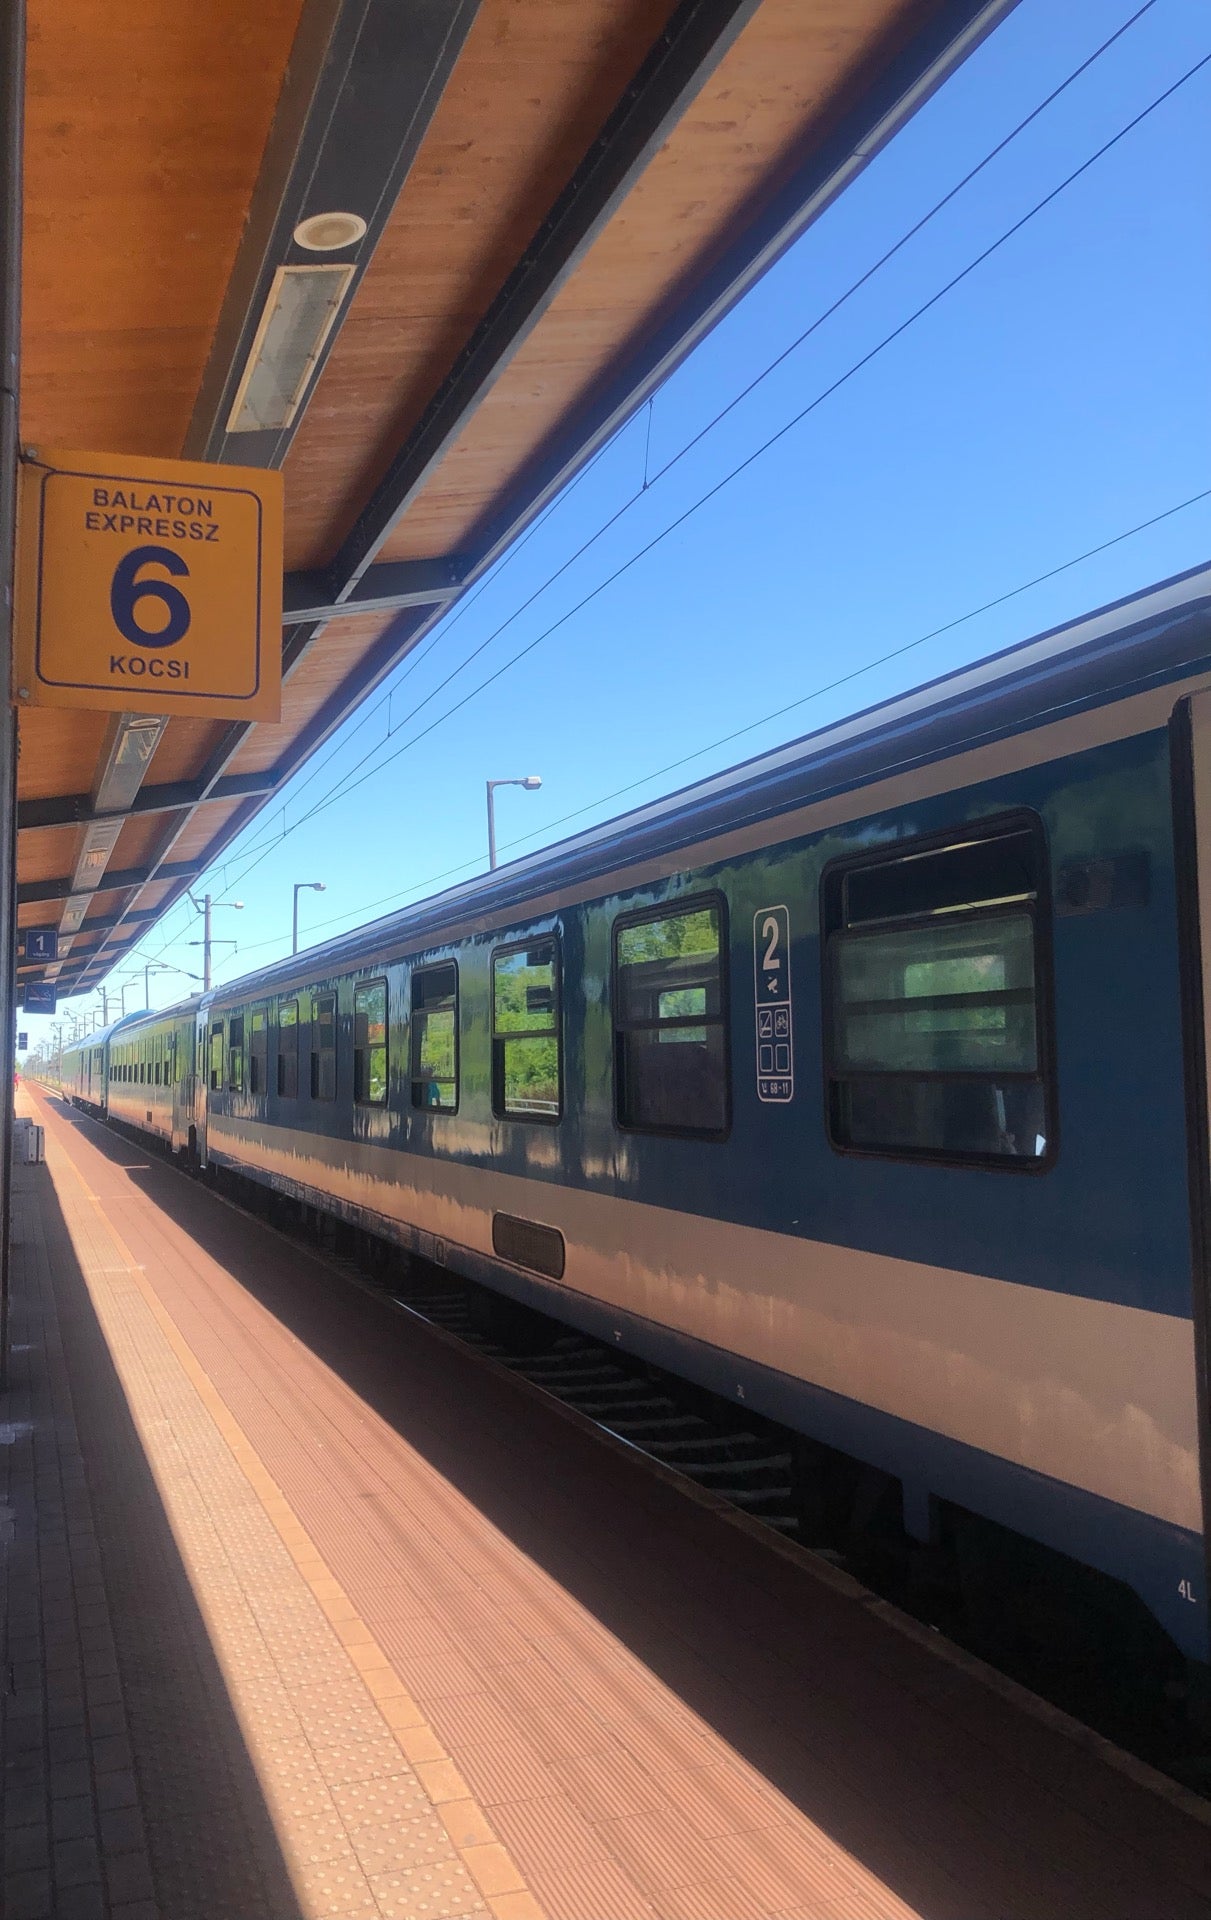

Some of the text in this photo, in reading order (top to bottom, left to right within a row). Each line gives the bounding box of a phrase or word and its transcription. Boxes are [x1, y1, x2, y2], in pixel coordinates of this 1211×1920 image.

[93, 488, 213, 517] BALATON
[85, 512, 220, 542] EXPRESSZ
[110, 545, 191, 649] 6
[109, 656, 190, 679] KOCSI
[36, 935, 44, 951] 1
[762, 916, 780, 970] 2
[1178, 1579, 1196, 1602] 4L
